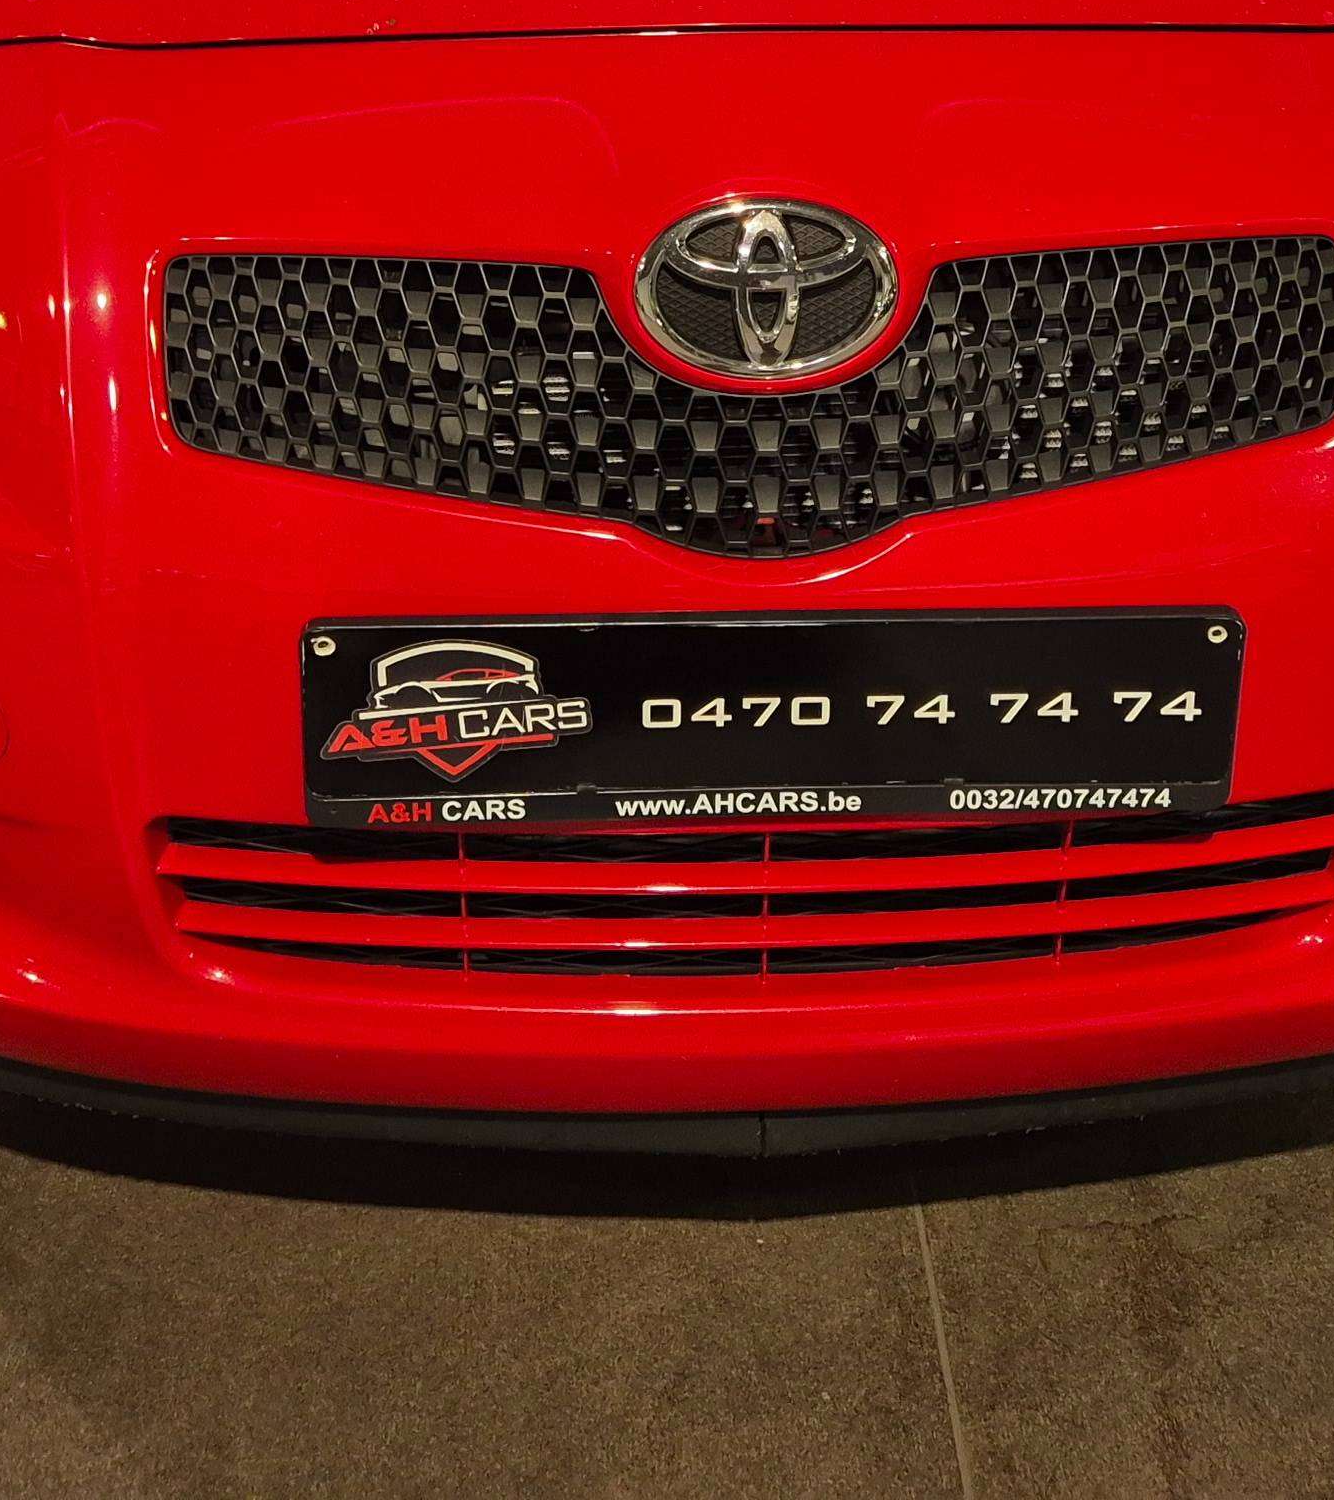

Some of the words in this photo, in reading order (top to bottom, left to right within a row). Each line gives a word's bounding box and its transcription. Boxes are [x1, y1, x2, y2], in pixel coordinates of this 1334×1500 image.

[641, 696, 831, 728] 0470
[866, 694, 956, 725] 74
[989, 692, 1079, 723] 74
[1113, 690, 1202, 722] 74
[327, 714, 449, 753] A&H
[457, 700, 588, 740] CARS
[367, 802, 432, 823] A&H
[441, 799, 527, 822] CARS
[615, 791, 862, 817] www.AHCARS.be
[949, 788, 1172, 810] 0032/470747474
